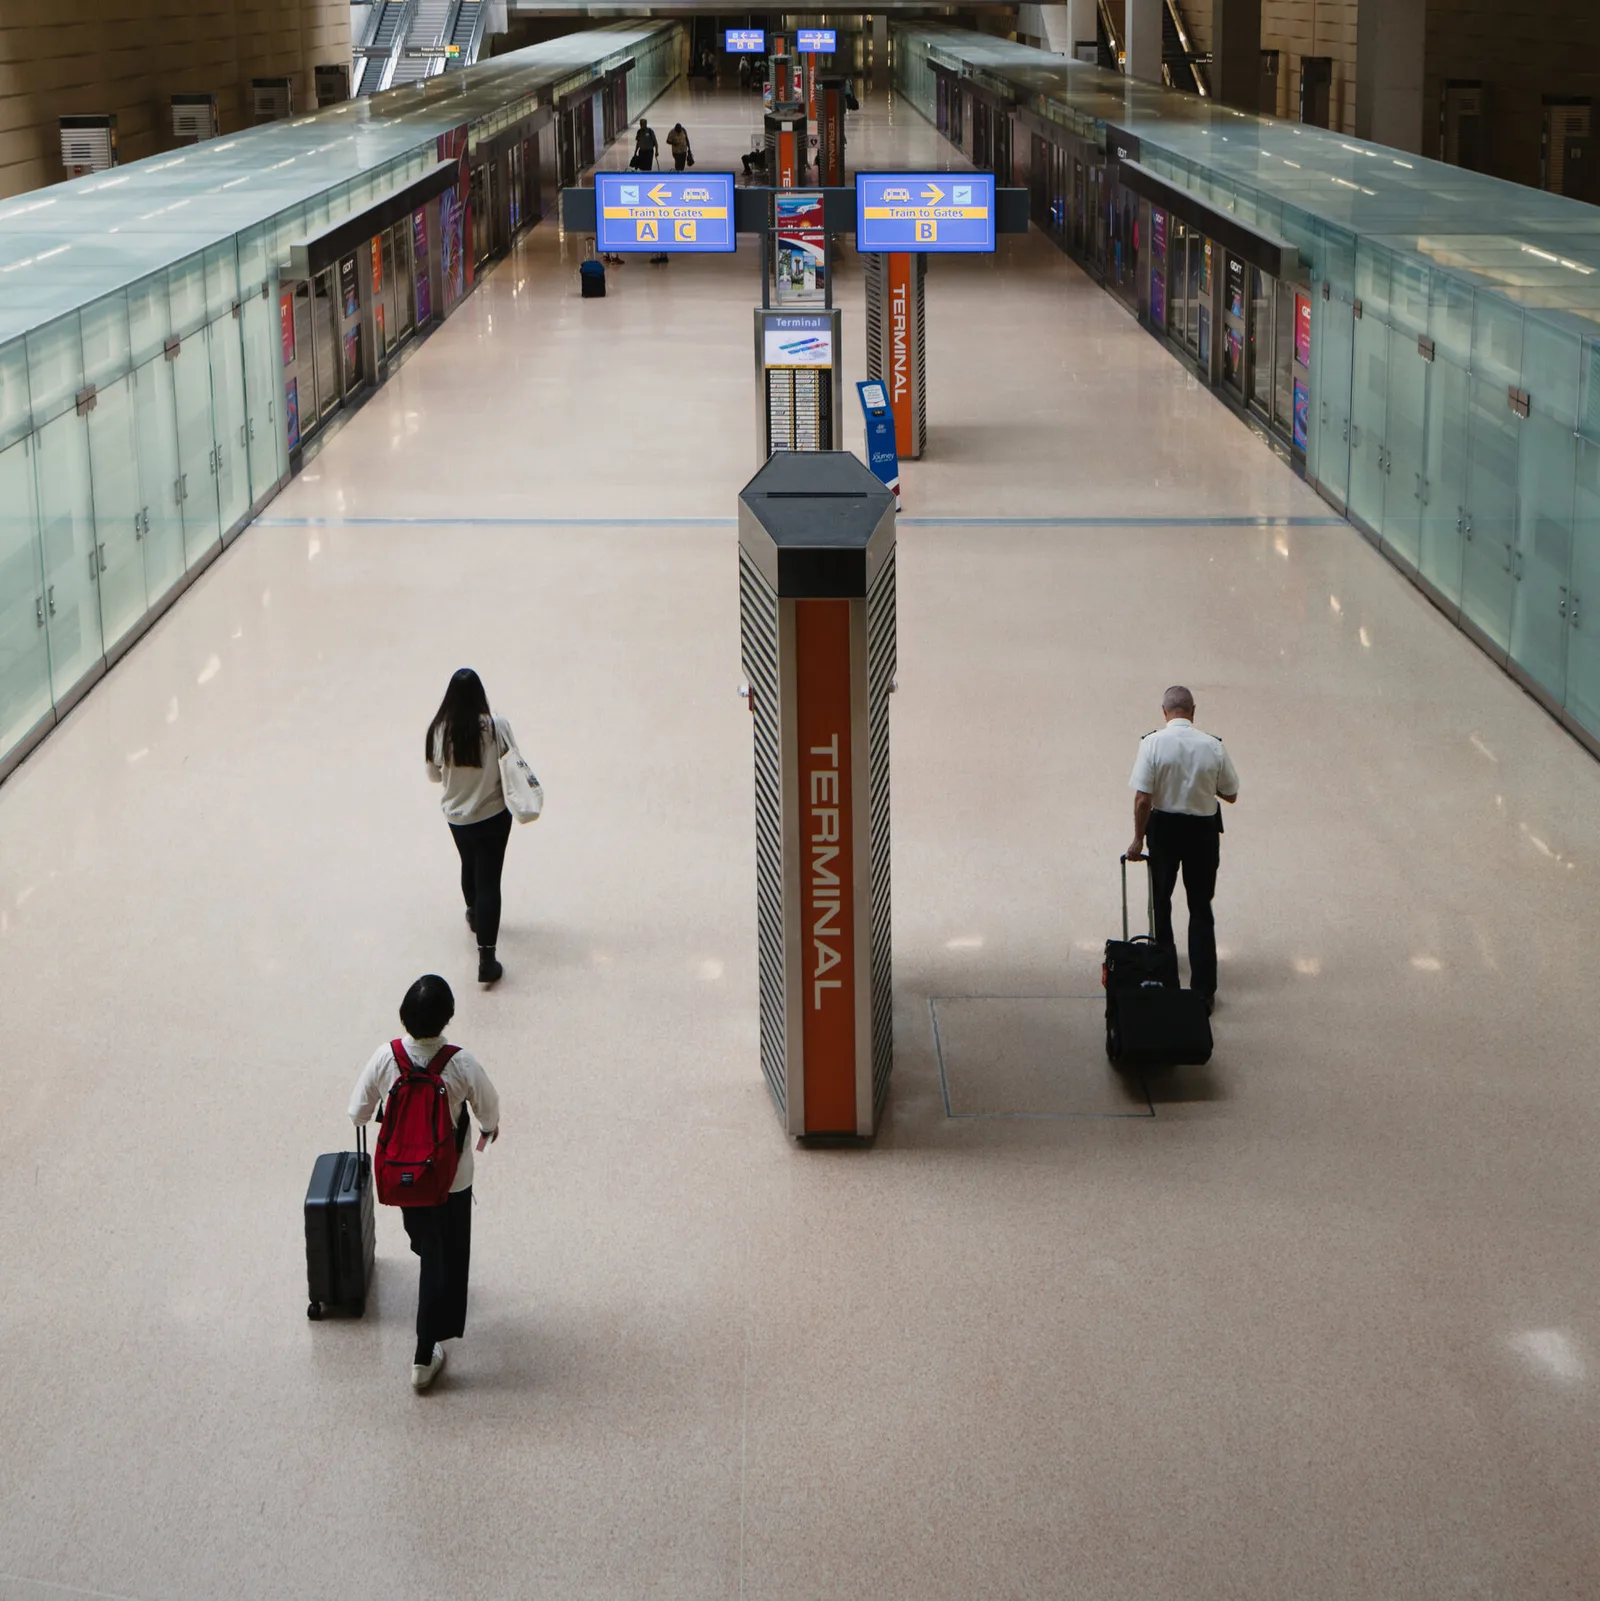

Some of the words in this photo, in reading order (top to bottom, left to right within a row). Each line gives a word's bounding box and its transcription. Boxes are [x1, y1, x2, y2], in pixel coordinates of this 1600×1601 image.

[828, 115, 836, 170] TERMINAL
[629, 208, 656, 218] Train
[659, 208, 670, 218] to
[673, 208, 703, 218] Gates
[889, 208, 916, 218] Train
[919, 208, 930, 218] to
[933, 208, 963, 218] Gates
[640, 223, 655, 239] A
[679, 223, 692, 239] C
[920, 223, 933, 239] B
[775, 318, 821, 327] Terminal
[893, 283, 907, 403] TERMINAL
[810, 733, 842, 1010] TERMINAL
